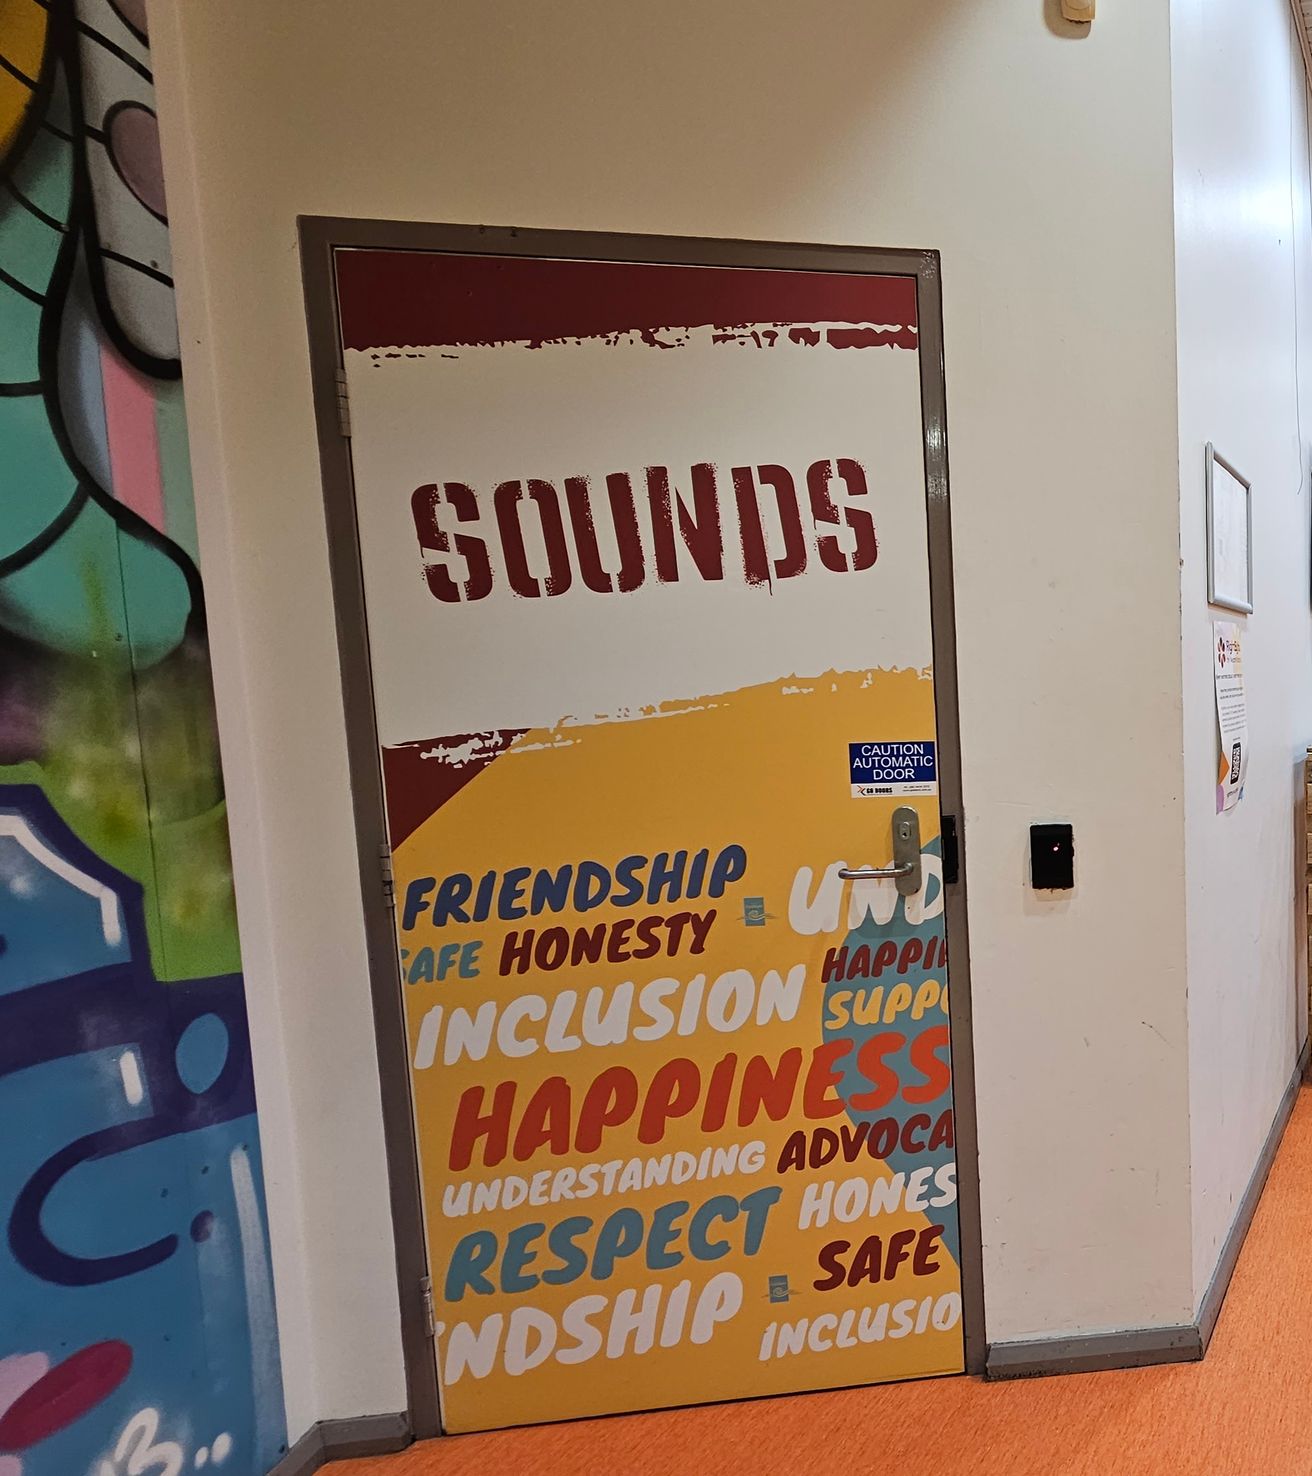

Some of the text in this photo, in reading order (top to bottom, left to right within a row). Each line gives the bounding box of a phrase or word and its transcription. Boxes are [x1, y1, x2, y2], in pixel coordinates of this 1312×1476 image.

[411, 459, 880, 602] SOUNDS
[853, 755, 933, 769] AUTOMATIC
[861, 744, 924, 756] CAUTION
[873, 768, 915, 780] DOOR
[402, 844, 747, 931] FRIENDSHIP
[788, 853, 944, 935] UND
[499, 909, 718, 976] HONESTY
[821, 935, 949, 983] HAPPI
[414, 964, 807, 1070] INCLUSION
[448, 1025, 952, 1172] HAPPINESS
[442, 1089, 954, 1218] UNDERSTANDING ADVOCA
[444, 1163, 957, 1302] RESPECT HONES
[813, 1225, 945, 1291] SAFE
[435, 1272, 744, 1385] NDSHIP
[759, 1292, 962, 1361] INCLUSIO
